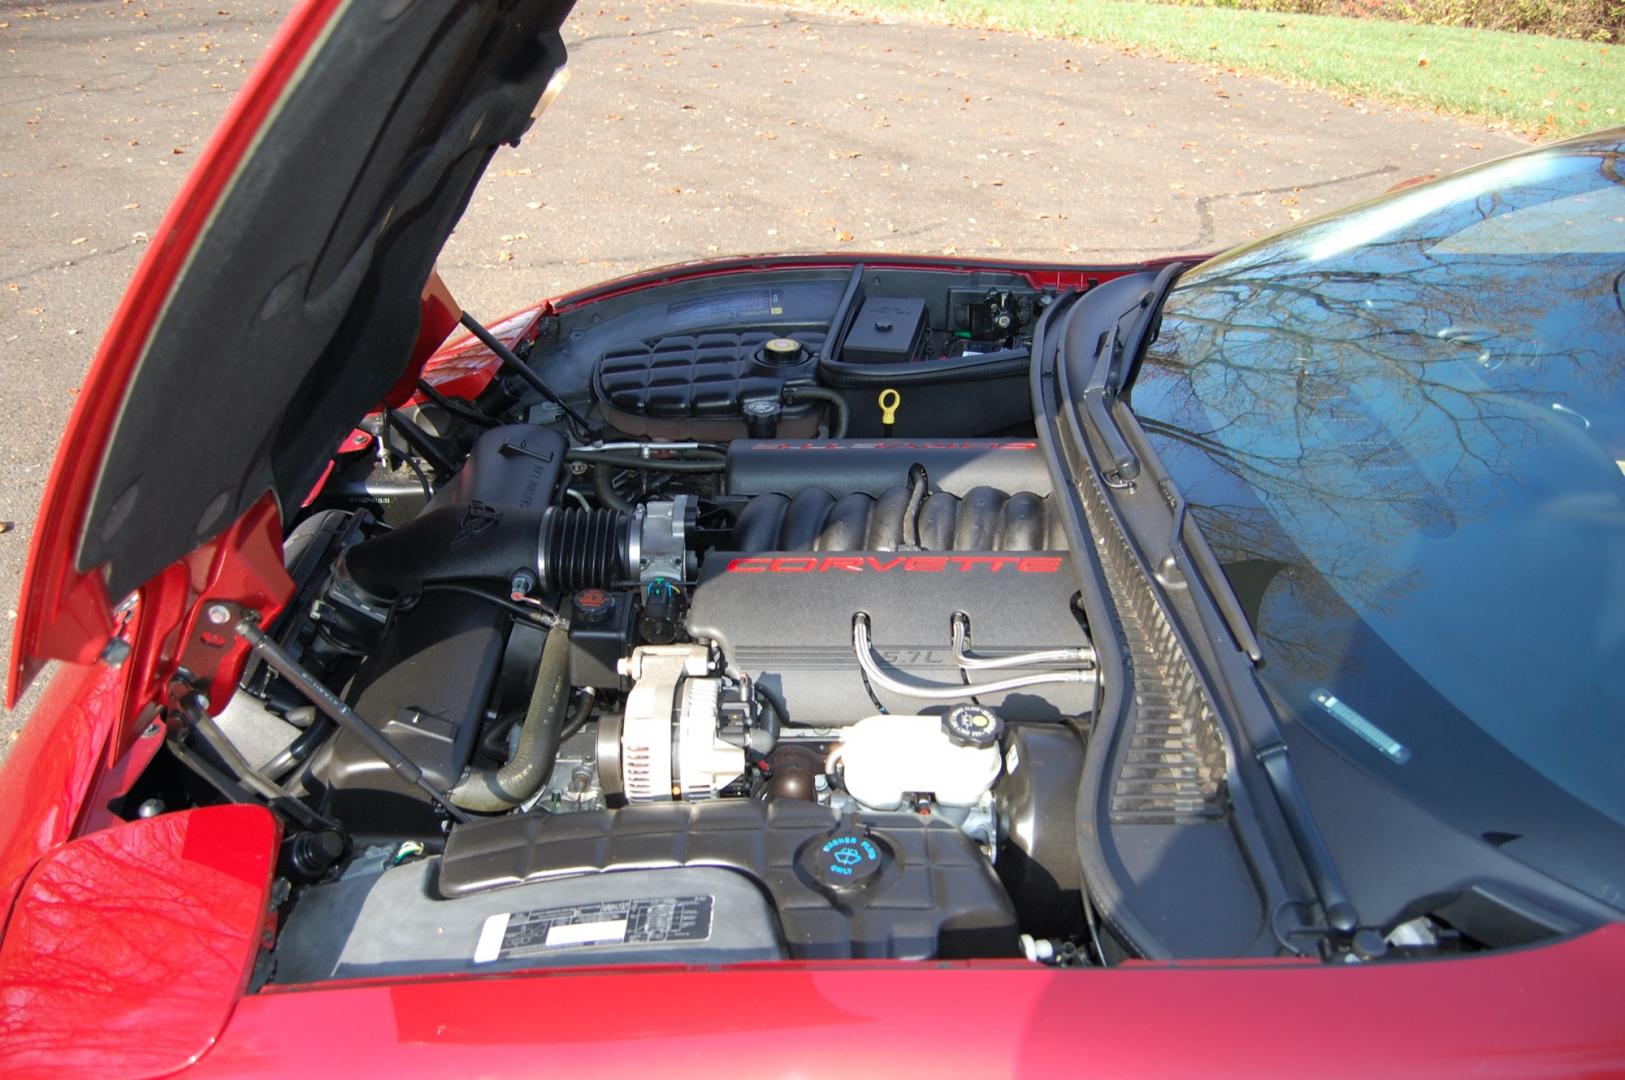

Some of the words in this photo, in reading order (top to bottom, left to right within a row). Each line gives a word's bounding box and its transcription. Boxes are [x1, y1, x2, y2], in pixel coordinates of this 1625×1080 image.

[727, 556, 1063, 573] CORVETTE
[884, 650, 944, 665] 5.7L
[823, 837, 857, 852] WASHER
